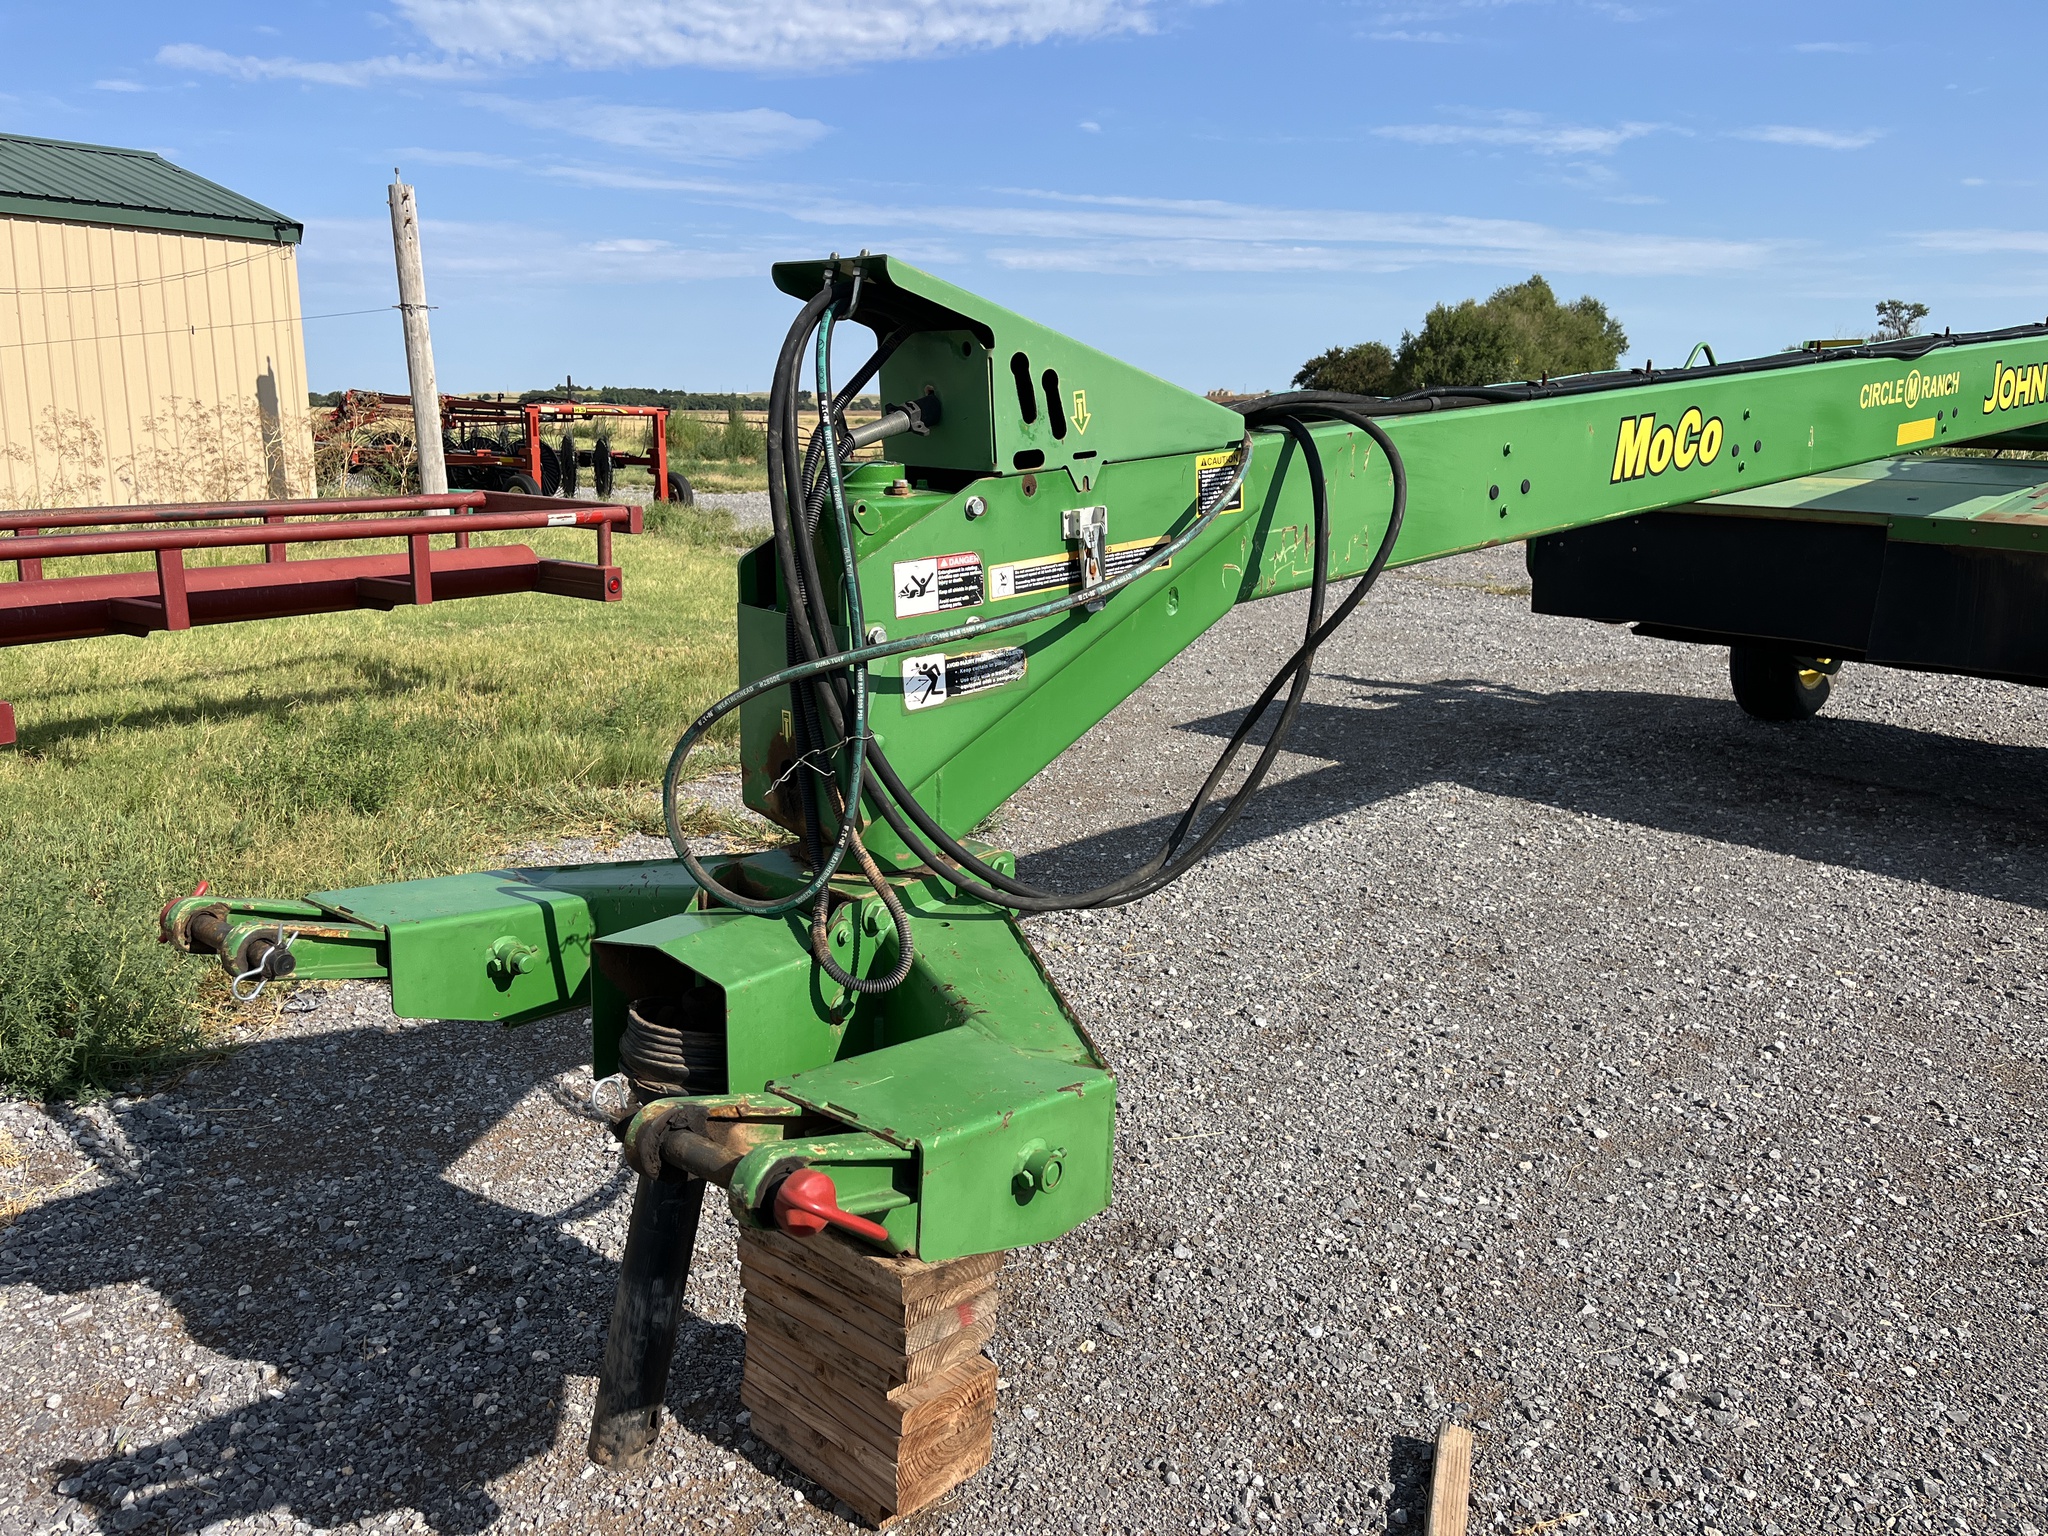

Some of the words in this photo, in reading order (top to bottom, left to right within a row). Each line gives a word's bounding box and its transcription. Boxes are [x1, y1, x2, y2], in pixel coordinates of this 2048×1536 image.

[1860, 379, 1904, 409] CIRCLE
[1906, 374, 1919, 405] M
[1921, 371, 1960, 400] RANCH
[1983, 360, 2048, 414] JOHN
[824, 429, 838, 478] WEATHERHEAD
[1207, 454, 1239, 466] CAUTION
[1610, 405, 1724, 485] MoCo
[949, 555, 979, 566] DANGER
[716, 686, 755, 711] WEATHERHEAD
[815, 850, 841, 888] WEATHERHEAD
